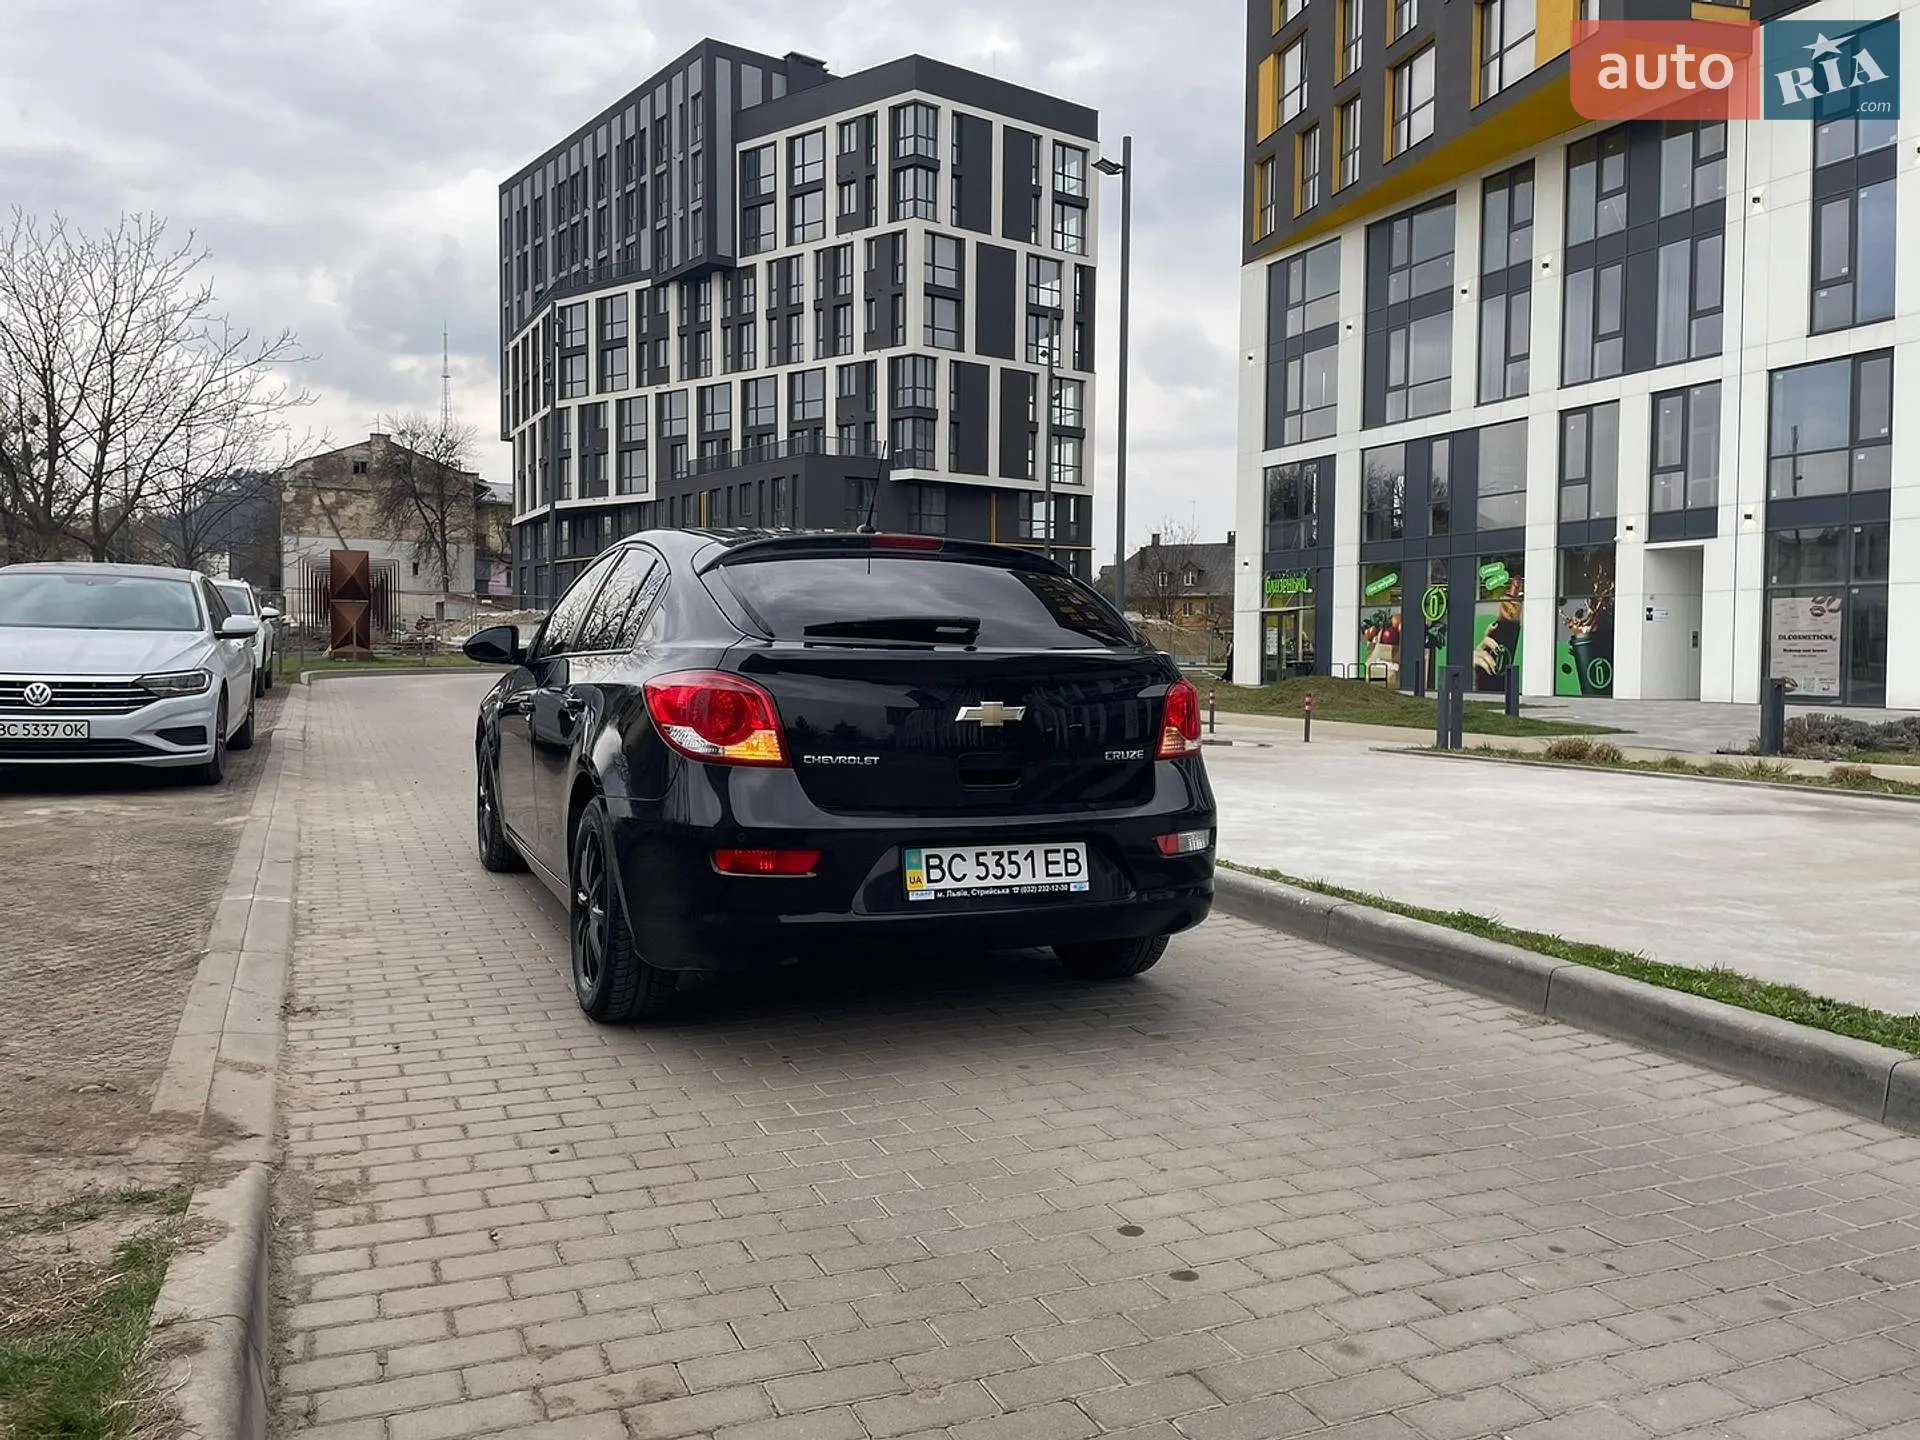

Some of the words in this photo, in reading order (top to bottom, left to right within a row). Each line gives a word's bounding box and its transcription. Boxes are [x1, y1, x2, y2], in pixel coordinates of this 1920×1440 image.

[22, 723, 60, 737] 5337
[62, 723, 87, 737] OK
[803, 754, 880, 766] CHEVROLET
[1104, 749, 1145, 762] CRUZE
[924, 853, 968, 884] BC
[974, 849, 1037, 882] 5351
[1043, 847, 1083, 878] EB
[909, 875, 923, 885] UA
